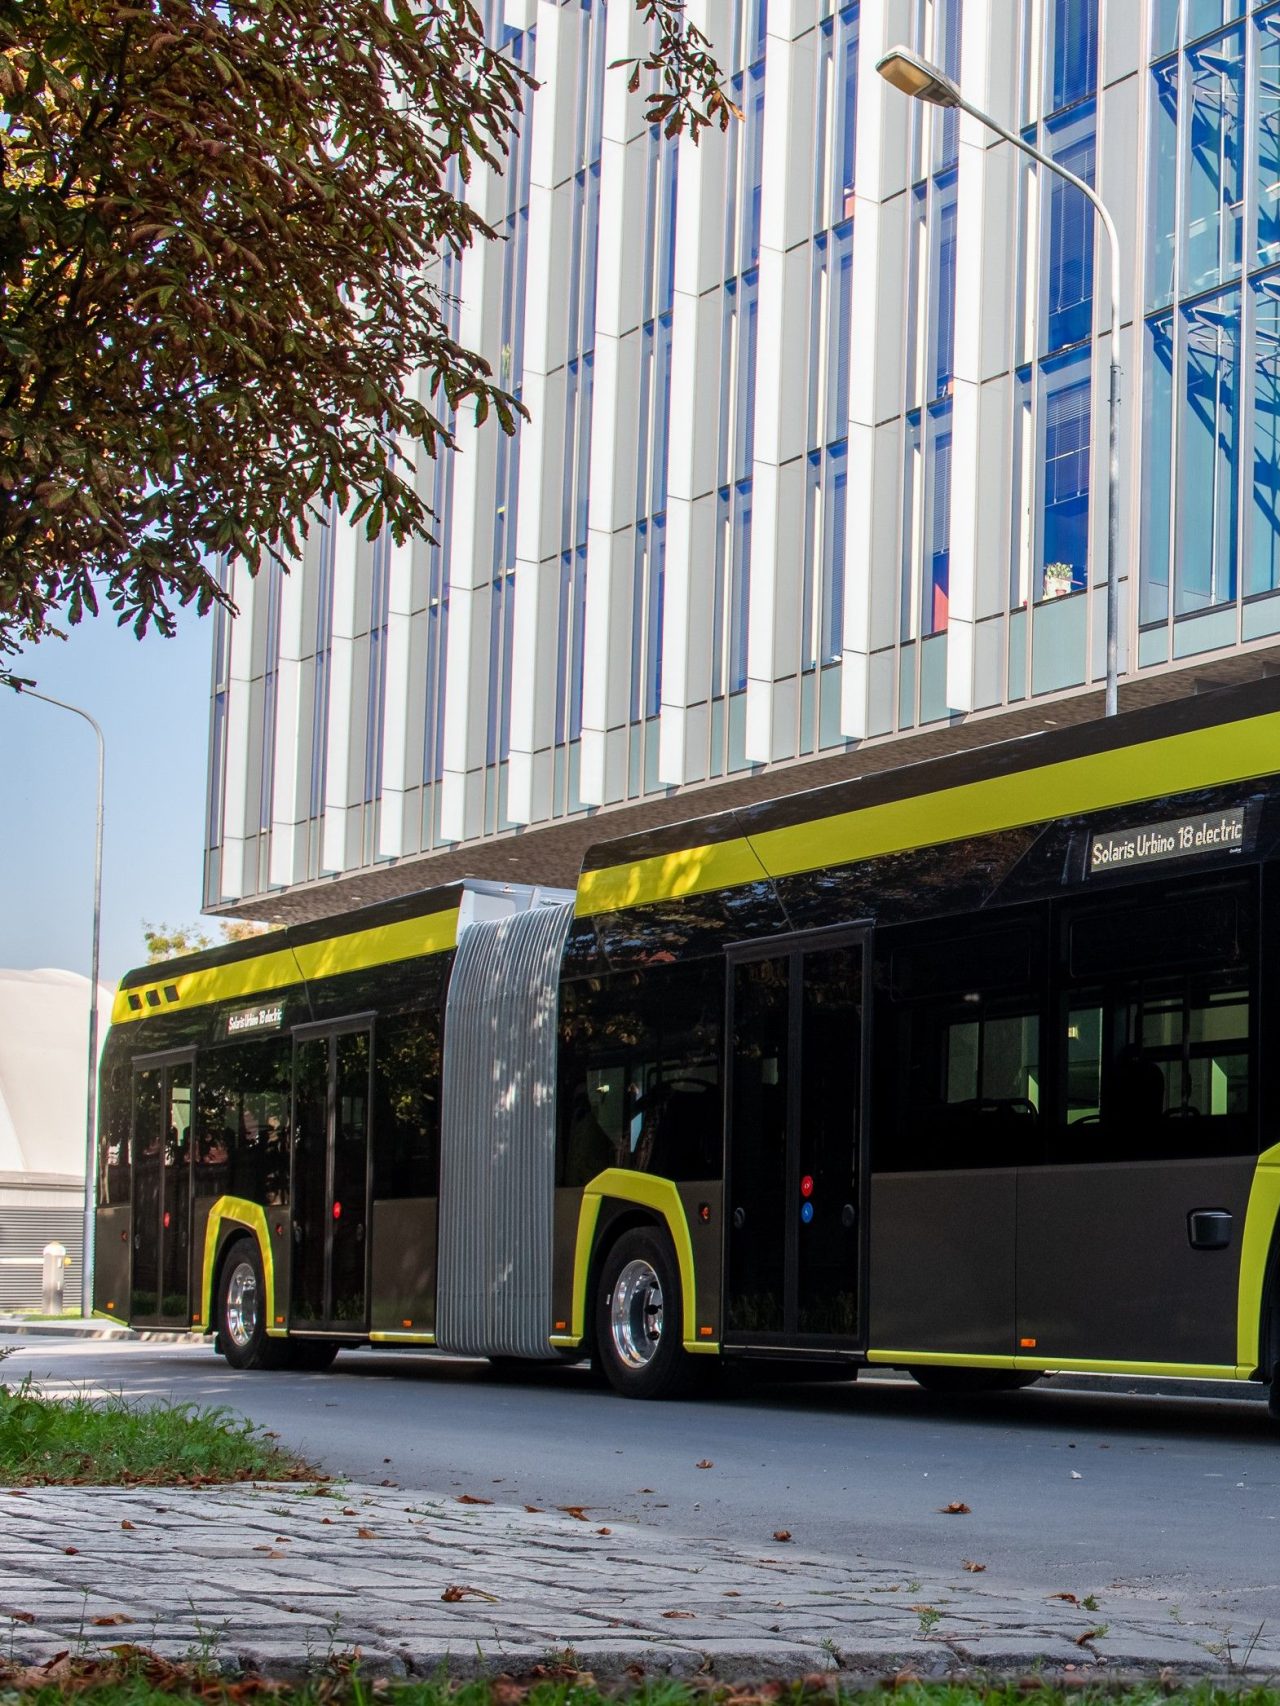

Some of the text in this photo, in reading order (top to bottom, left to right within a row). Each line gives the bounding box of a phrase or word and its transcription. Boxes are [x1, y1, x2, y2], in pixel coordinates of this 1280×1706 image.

[1092, 819, 1242, 865] Solaris Urbino 18 electric
